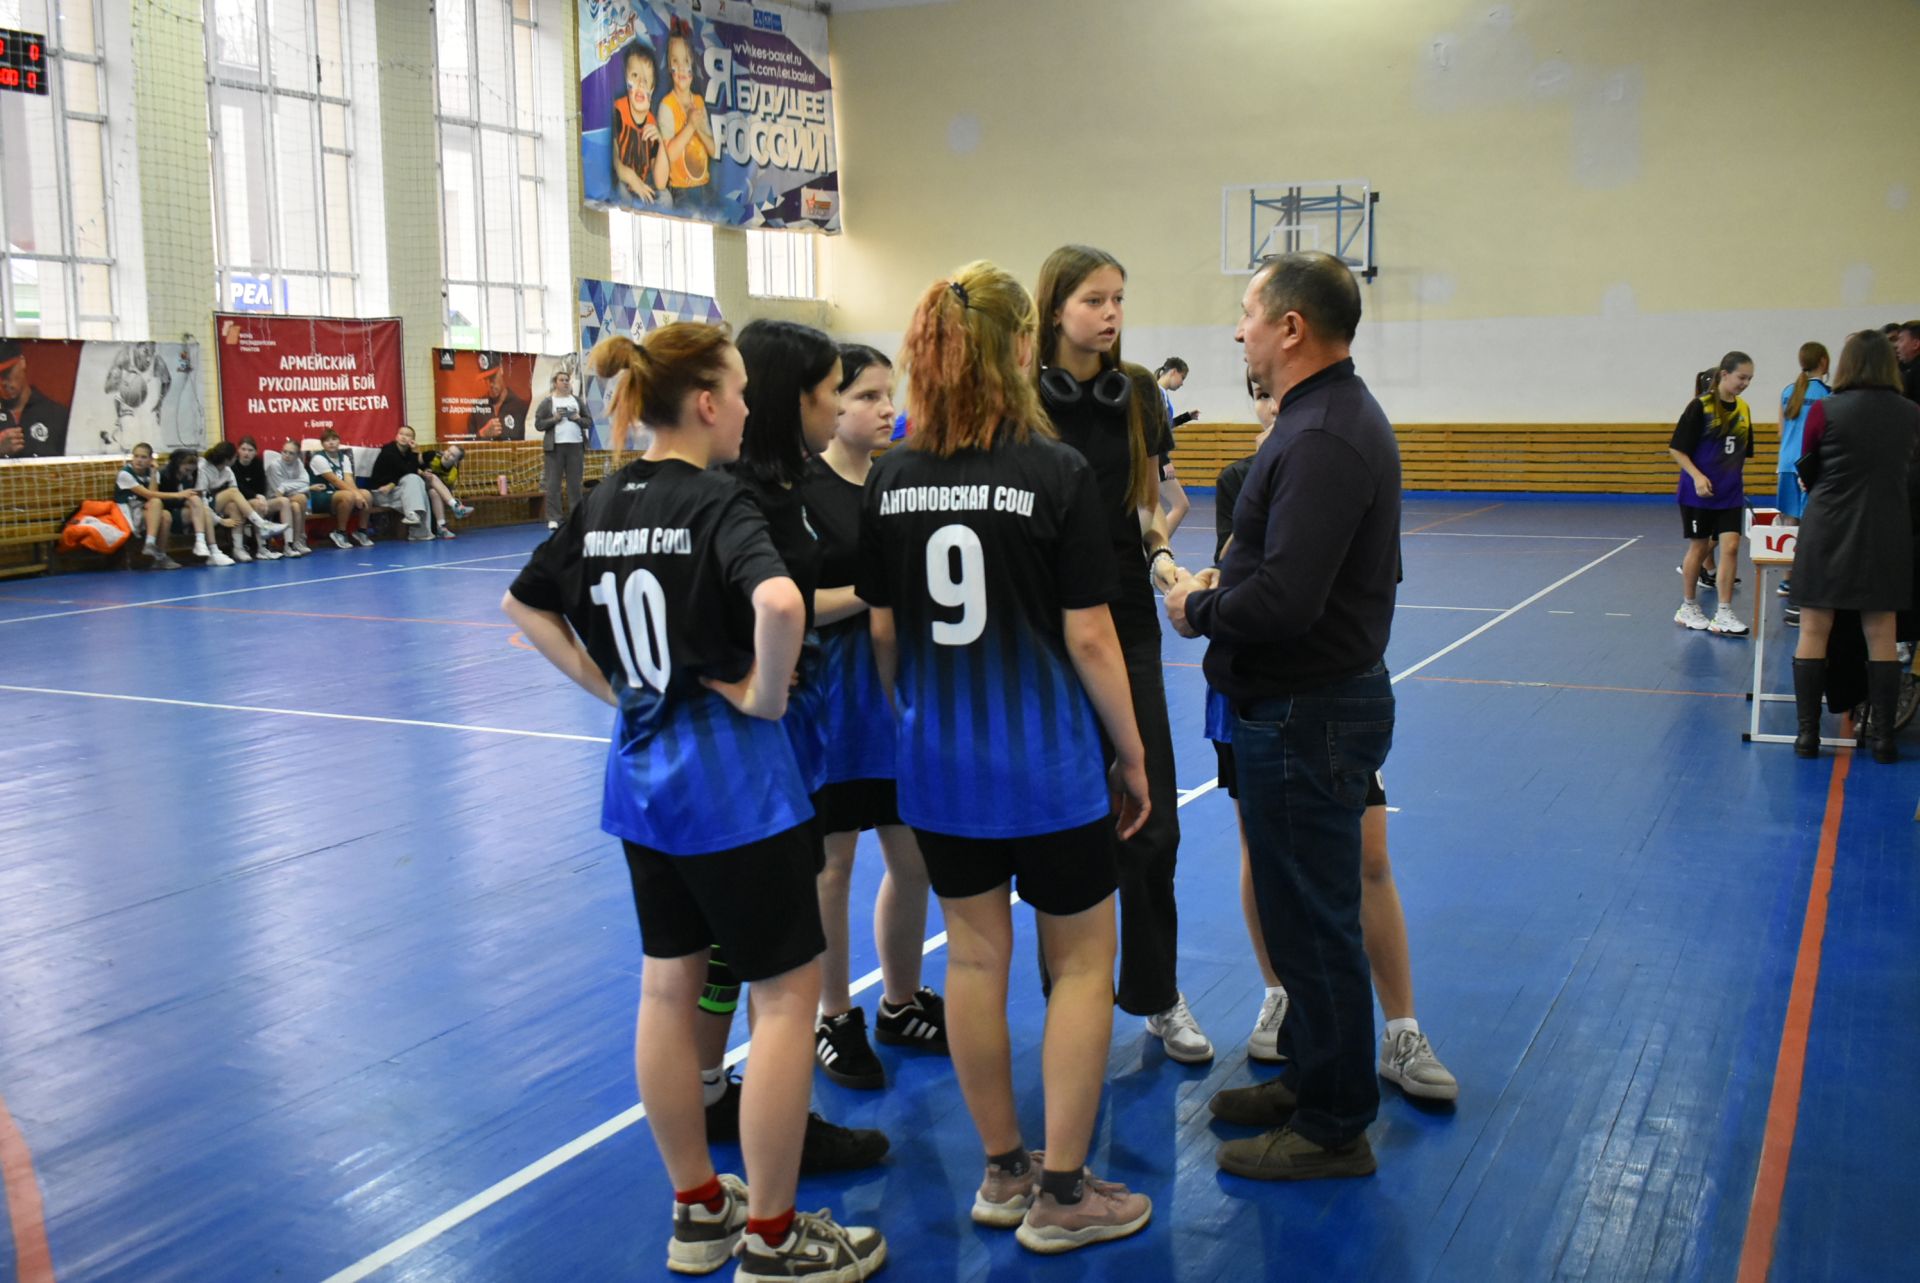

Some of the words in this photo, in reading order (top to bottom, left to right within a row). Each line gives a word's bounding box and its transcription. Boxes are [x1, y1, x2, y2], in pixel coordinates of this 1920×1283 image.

[703, 47, 733, 107] Я
[737, 79, 825, 126] БУДУЩЕЕ
[711, 113, 828, 174] РОССИИ
[280, 353, 357, 371] АРМЕЙСКИЙ
[259, 373, 350, 392] РУКОПАШНЫЙ
[352, 373, 376, 391] БОЙ
[248, 398, 267, 414] НА
[268, 397, 320, 413] СТРАЖЕ
[322, 395, 389, 412] ОТЕЧЕСТВА
[1724, 436, 1736, 454] 5
[879, 484, 990, 516] АНТОНОВСКАЯ
[993, 486, 1035, 517] СОШ
[651, 526, 692, 555] СОШ
[925, 523, 988, 646] 9
[589, 568, 672, 693] 10
